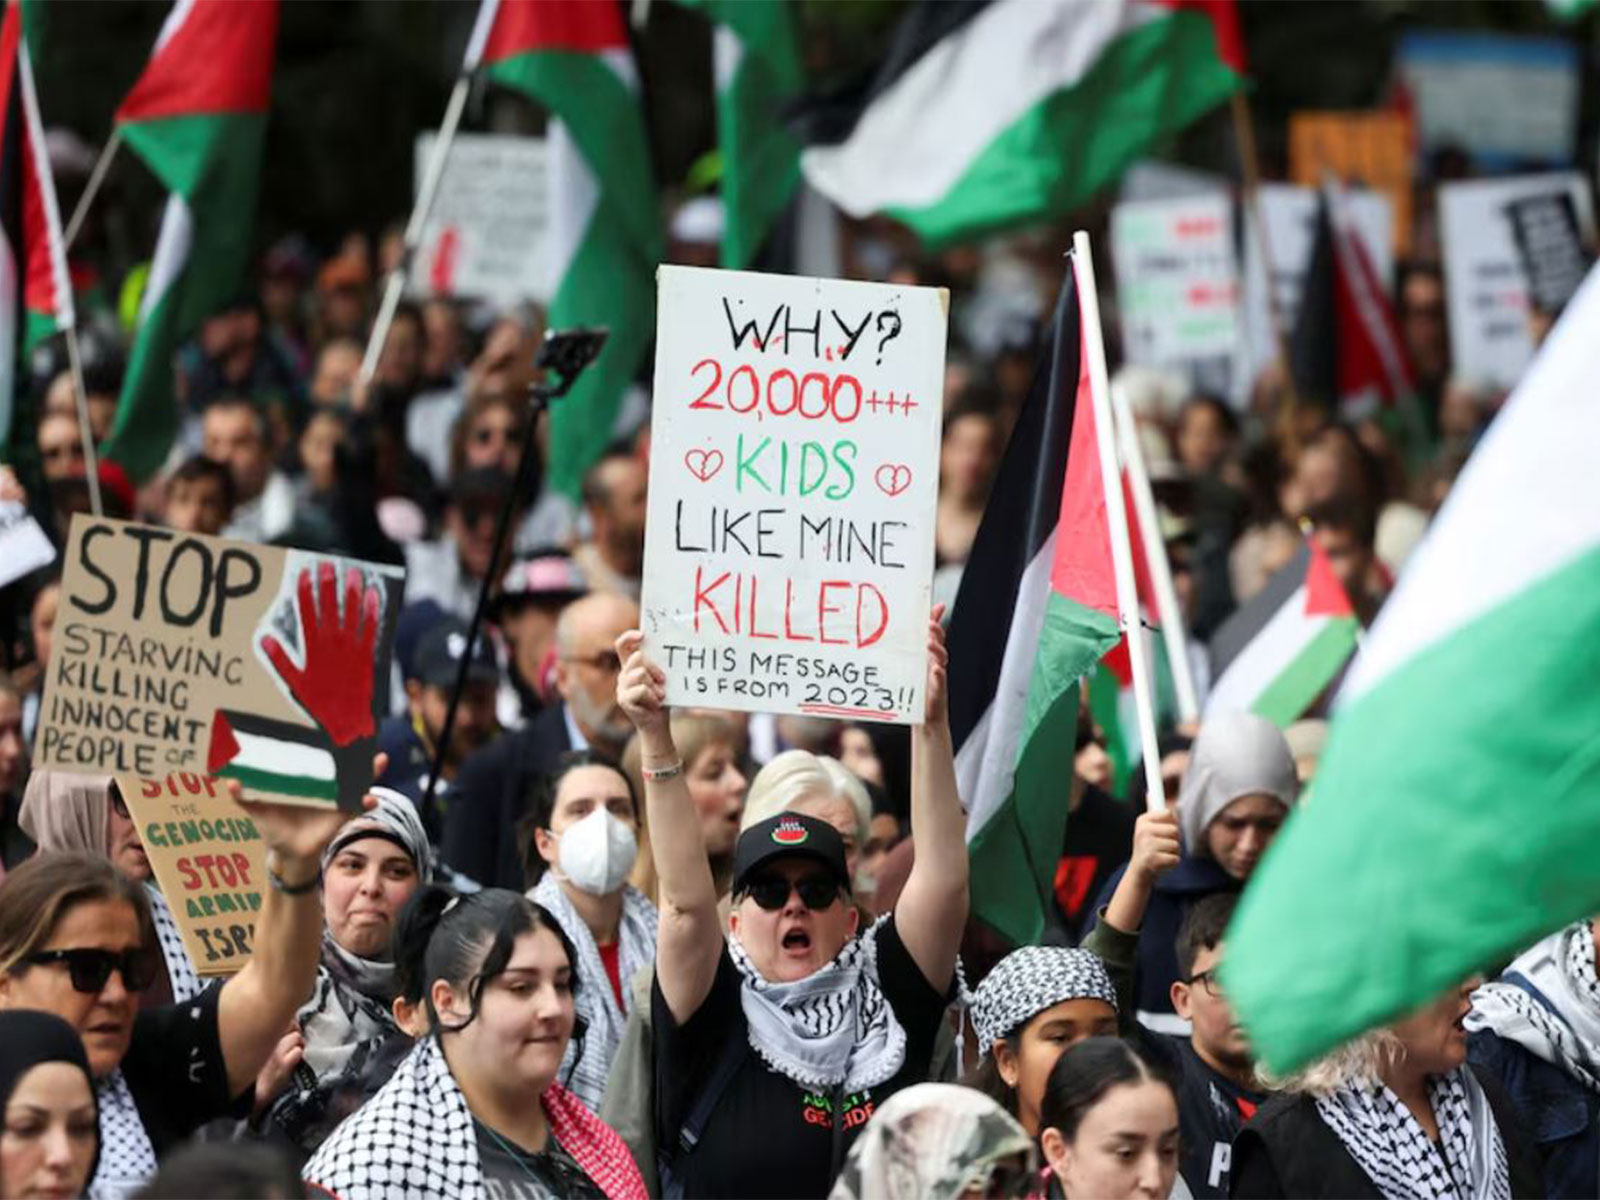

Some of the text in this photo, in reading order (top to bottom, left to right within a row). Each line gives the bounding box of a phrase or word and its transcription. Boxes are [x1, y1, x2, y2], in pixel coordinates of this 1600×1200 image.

[722, 297, 902, 366] WHY?
[735, 433, 857, 500] KIDS
[675, 499, 908, 568] LIKE MINE
[70, 524, 262, 638] STOP
[693, 565, 889, 649] KILLED
[57, 655, 190, 711] KILLING
[662, 644, 880, 687] THIS MESSAGE
[51, 695, 206, 743] INNOCENT
[684, 676, 915, 713] IS FROM 2023!!
[42, 726, 156, 776] PEOPLE
[176, 853, 251, 890] STOP
[194, 923, 255, 962] ISR
